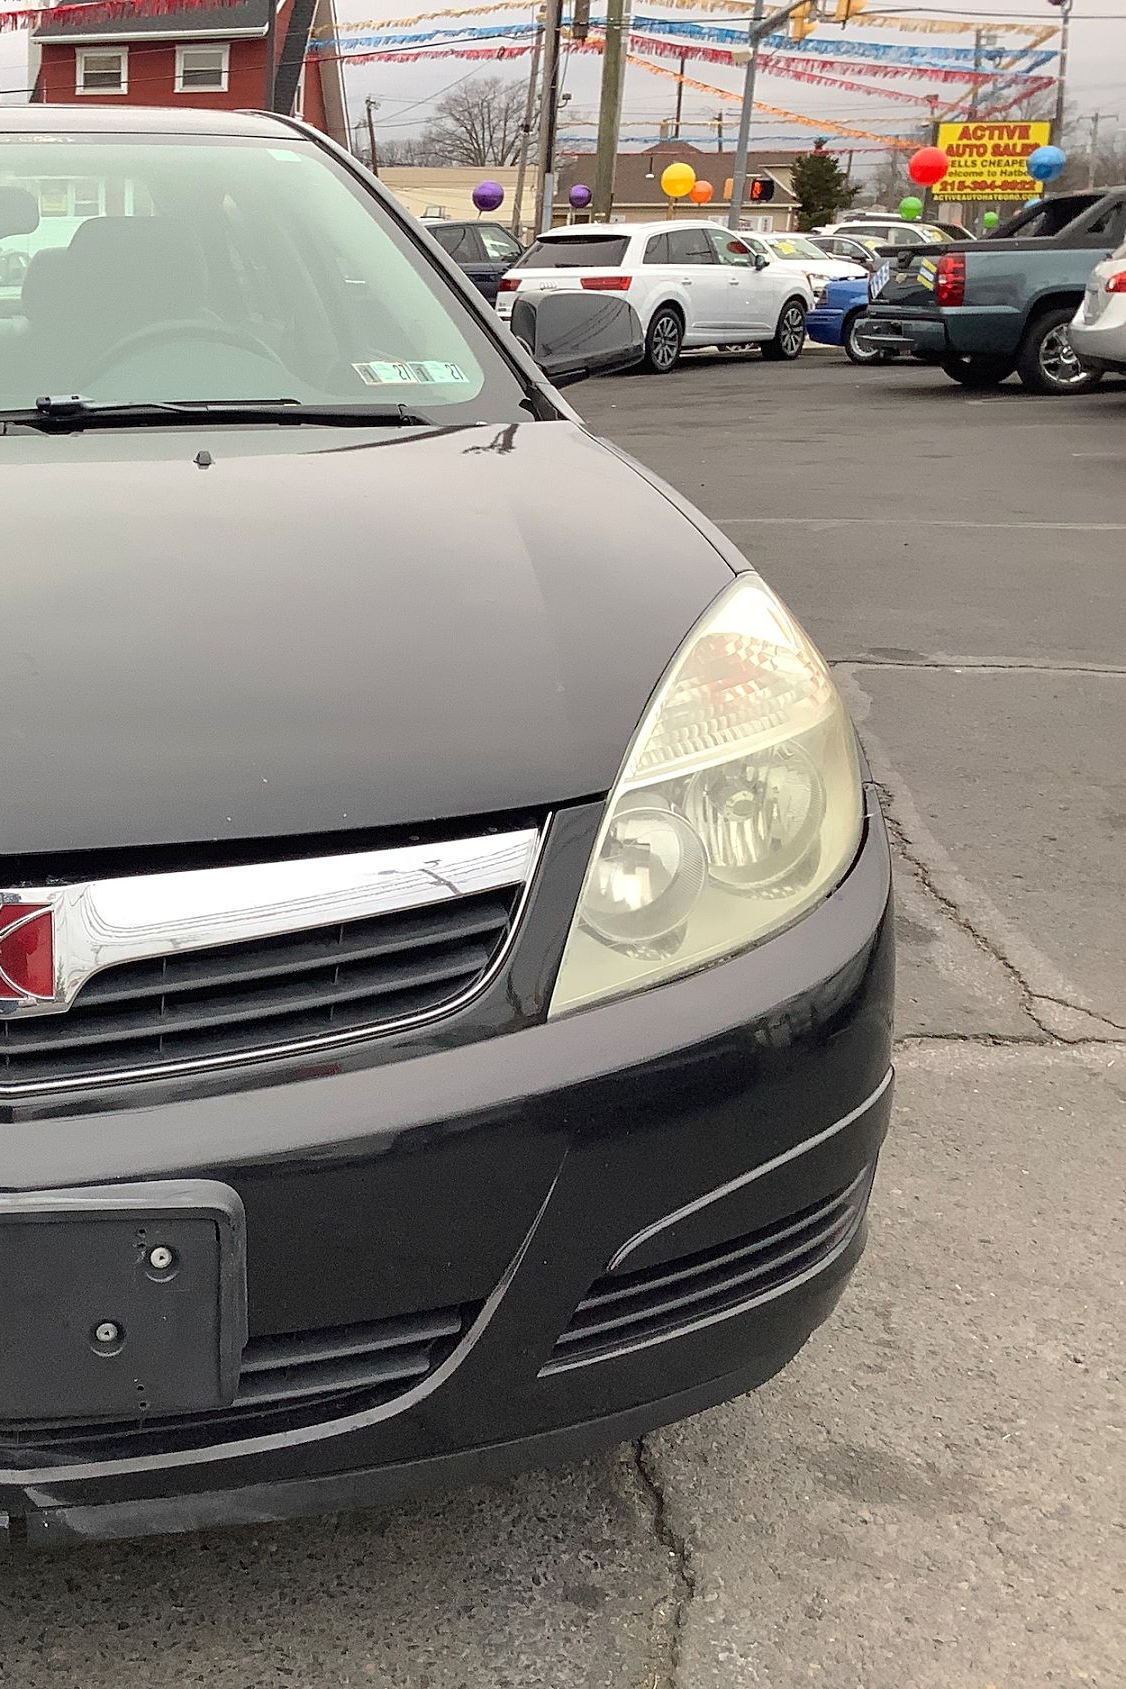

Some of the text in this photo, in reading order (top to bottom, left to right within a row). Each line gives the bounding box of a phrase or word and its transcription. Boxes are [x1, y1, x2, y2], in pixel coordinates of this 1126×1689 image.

[958, 125, 1031, 141] ACTIVE
[946, 143, 988, 157] AUTO
[950, 159, 1028, 168] ELLS CHEAPE
[1000, 169, 1029, 177] Hatbo
